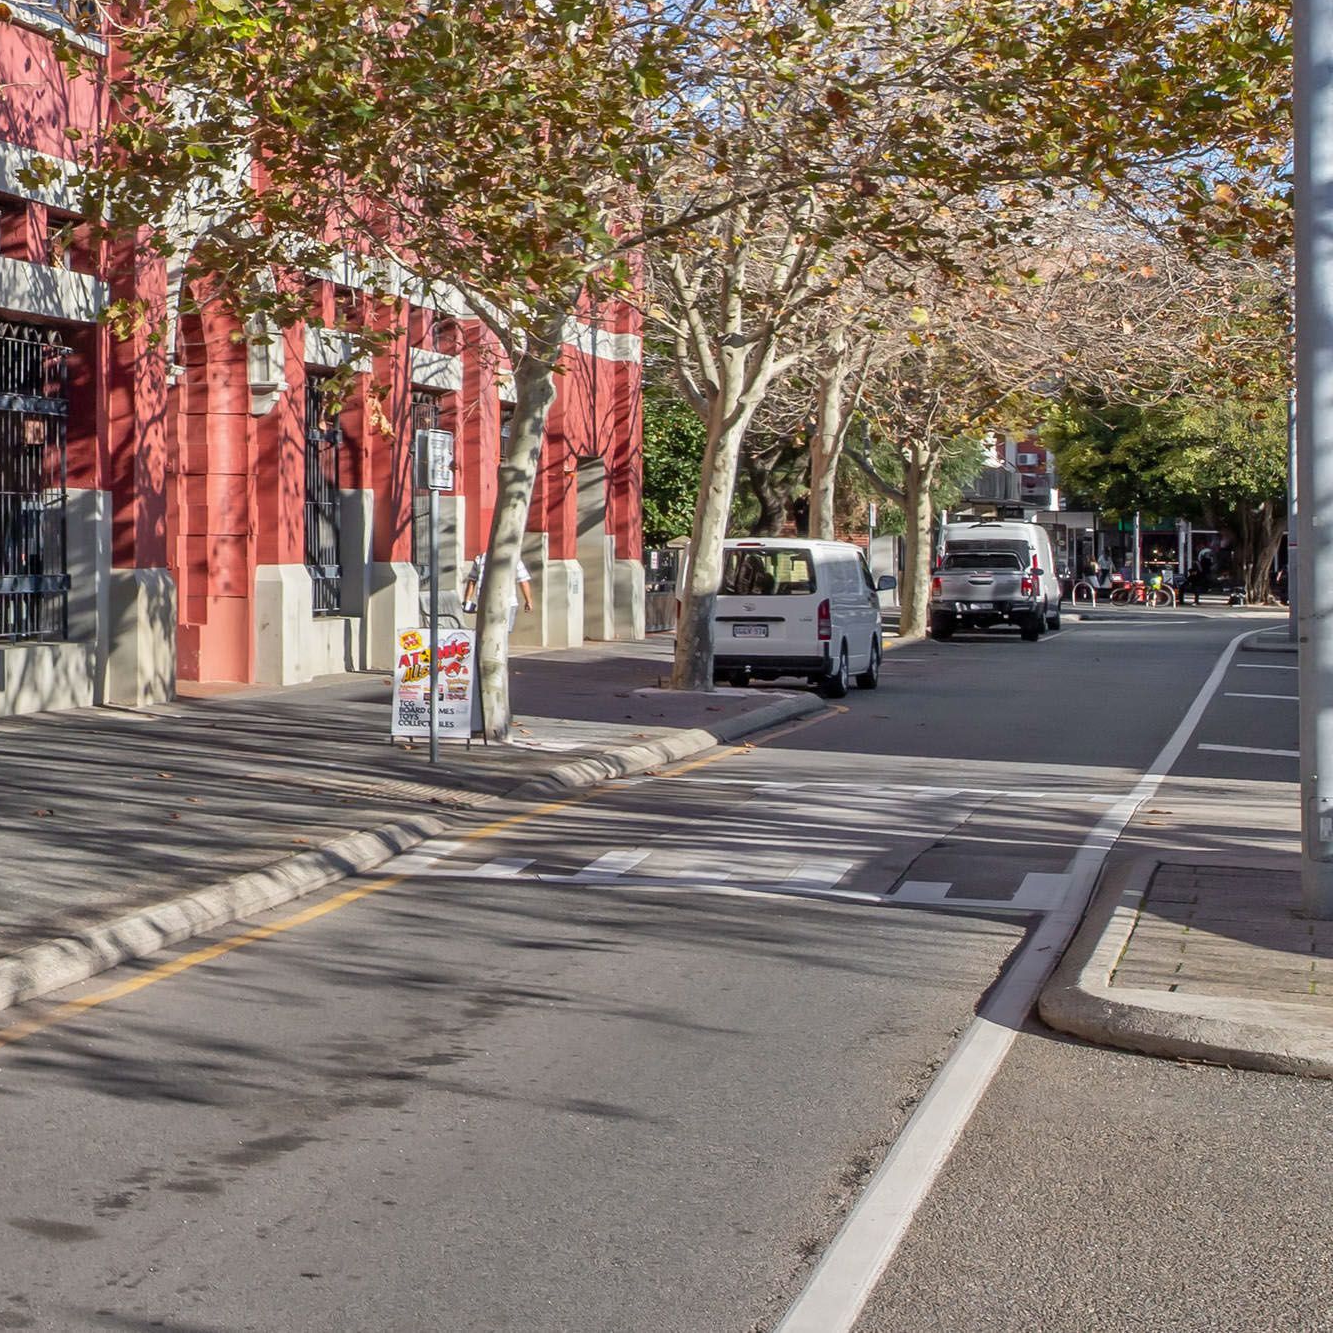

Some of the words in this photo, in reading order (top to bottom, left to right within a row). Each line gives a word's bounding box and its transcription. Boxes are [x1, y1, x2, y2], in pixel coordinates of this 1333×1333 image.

[399, 699, 415, 707] TCG
[399, 706, 426, 714] BOARD
[427, 707, 454, 715] GMES
